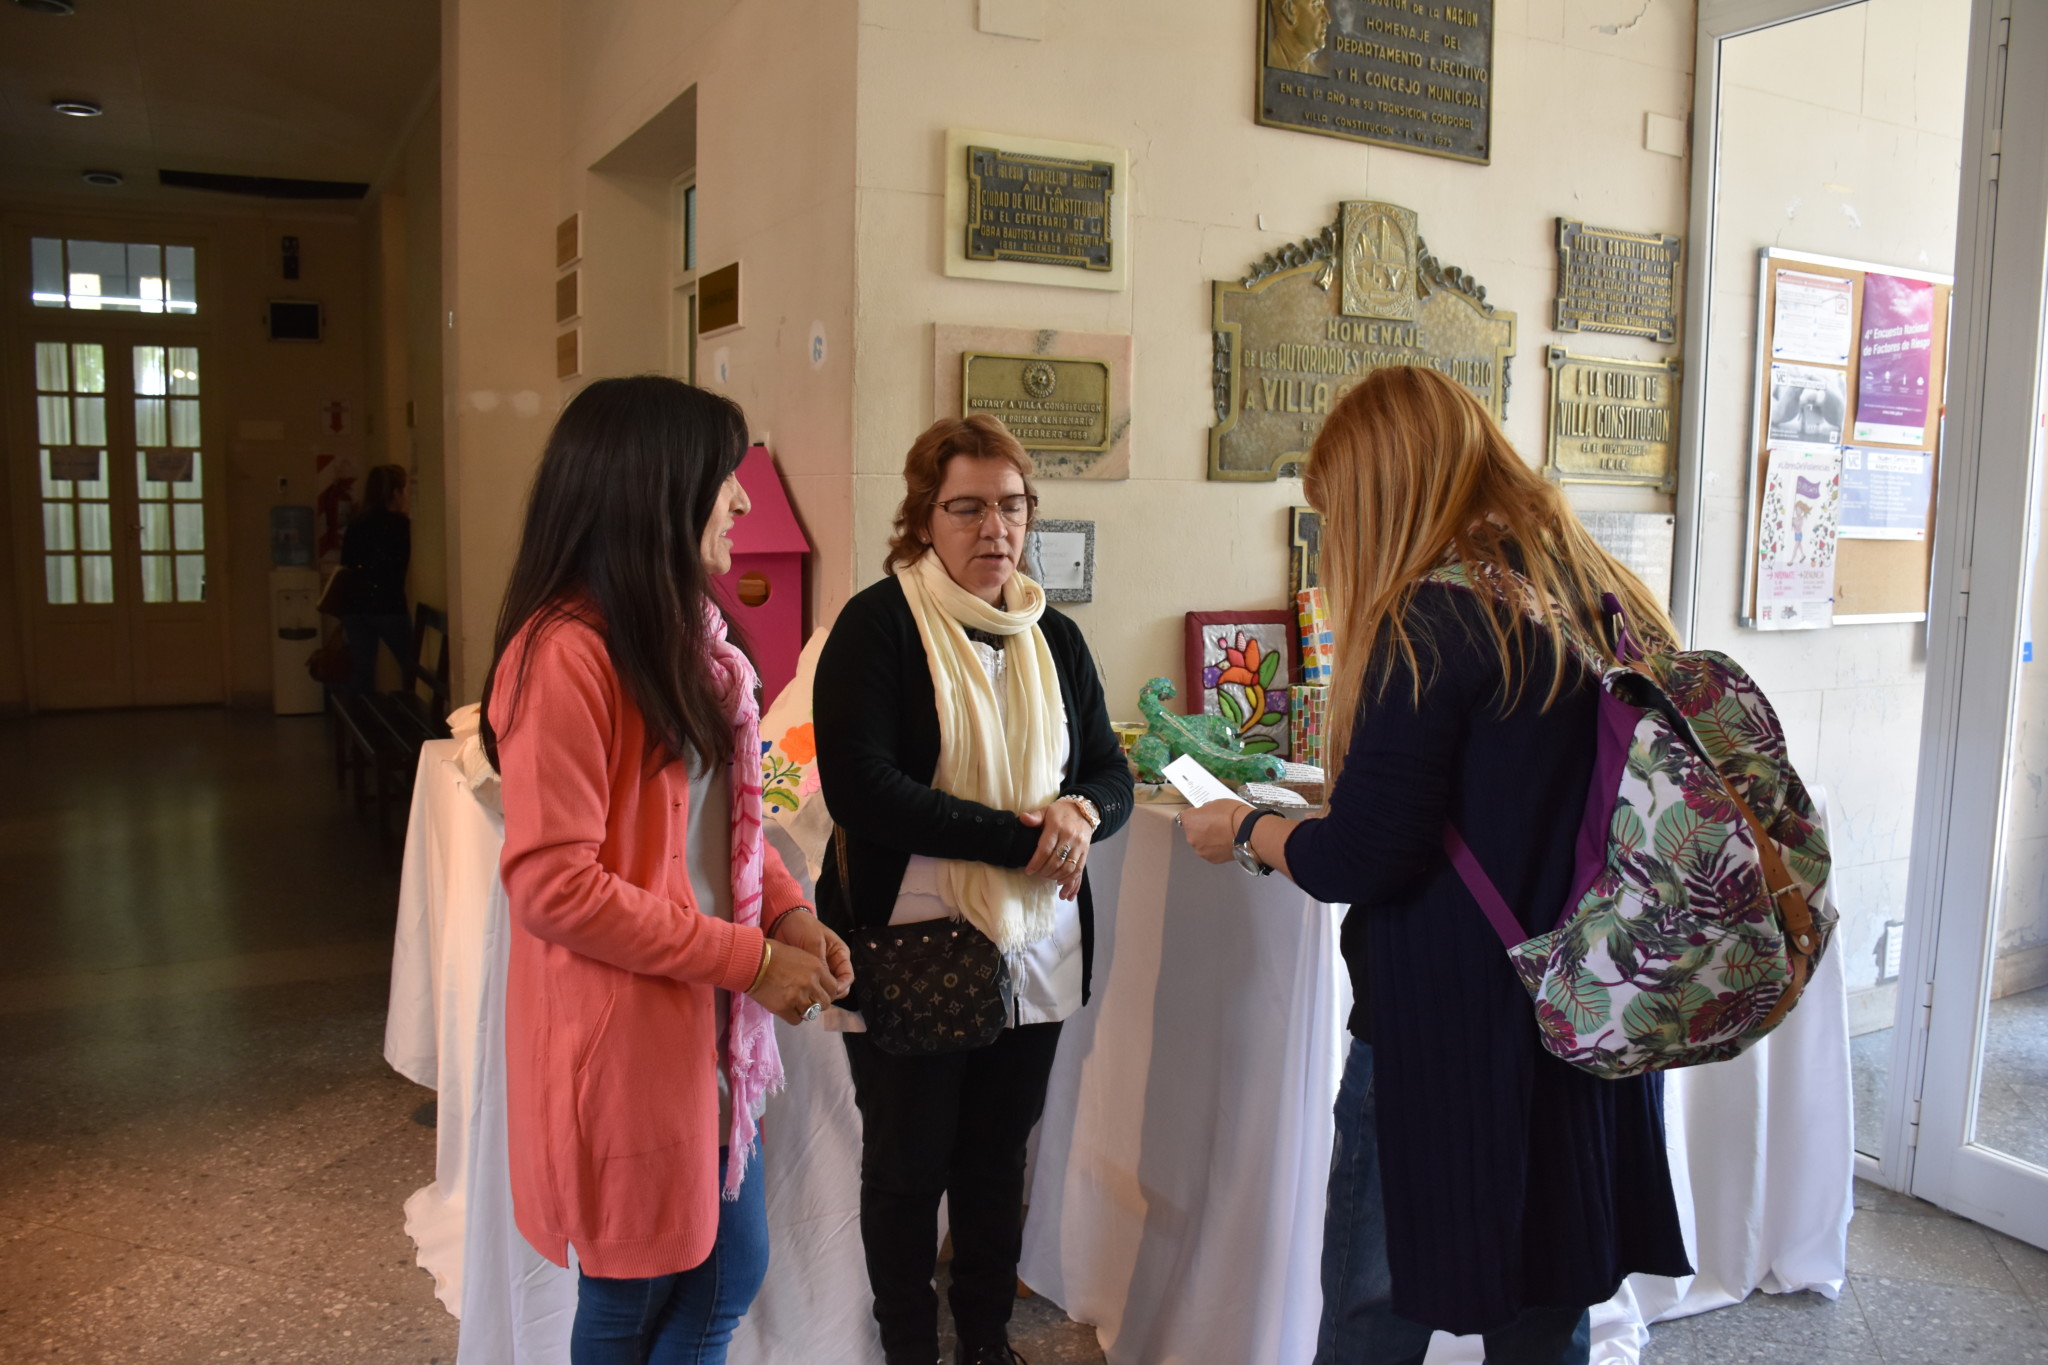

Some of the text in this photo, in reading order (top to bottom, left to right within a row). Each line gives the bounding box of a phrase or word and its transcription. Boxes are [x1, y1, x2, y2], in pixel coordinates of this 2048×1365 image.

[1413, 4, 1424, 15] DE
[1429, 8, 1439, 18] LA
[1445, 5, 1479, 27] NACION
[1366, 17, 1461, 50] HOMENAJE DEL
[1336, 36, 1488, 83] DEPARTAMENTO EJECUTIVO
[1335, 69, 1343, 80] Y
[1366, 71, 1420, 95] CONCEJO
[1428, 84, 1486, 110] MUNICIPAL
[1280, 82, 1293, 94] EN
[1297, 85, 1308, 98] EL
[1327, 89, 1345, 105] AÑO
[1350, 97, 1360, 108] DE
[1363, 100, 1374, 111] SU
[1377, 101, 1427, 121] TRANSICION
[1431, 112, 1475, 130] CORPORAL
[1304, 111, 1328, 123] VILLA
[1335, 116, 1394, 136] CONSTITUCION
[984, 164, 1101, 190] LA IGLESIA EVANGELICA BAUTISTA
[1022, 183, 1062, 196] A LA
[981, 190, 1104, 218] CIUDAD DE VILLA CONSTITUCION
[983, 209, 1101, 233] EN EL CENTENARIO DE LA
[981, 225, 1104, 248] OBRA BAUTISTA EN LA ARGENTINA
[1574, 235, 1670, 263] VILLA CONSTITUCION
[1327, 320, 1426, 349] HOMENAJE
[1873, 326, 1903, 339] Encuesta
[1863, 345, 1872, 357] de
[1873, 342, 1901, 355] Factores
[1244, 350, 1255, 367] DE
[1260, 351, 1277, 370] LAS
[1279, 343, 1359, 376] AUTORIDADES
[1452, 359, 1492, 387] PUEBLO
[1244, 389, 1255, 411] A
[1261, 376, 1329, 414] VILLA
[1577, 369, 1657, 401] A LA CIUDAD DE
[971, 400, 1102, 412] ROTARY A VILLA CONSTITUCION
[1009, 415, 1038, 424] PRIMER
[1042, 415, 1094, 426] CENTENARIO
[1023, 429, 1062, 438] FEBRERO
[1560, 402, 1670, 442] VILLA CONSTITUCION
